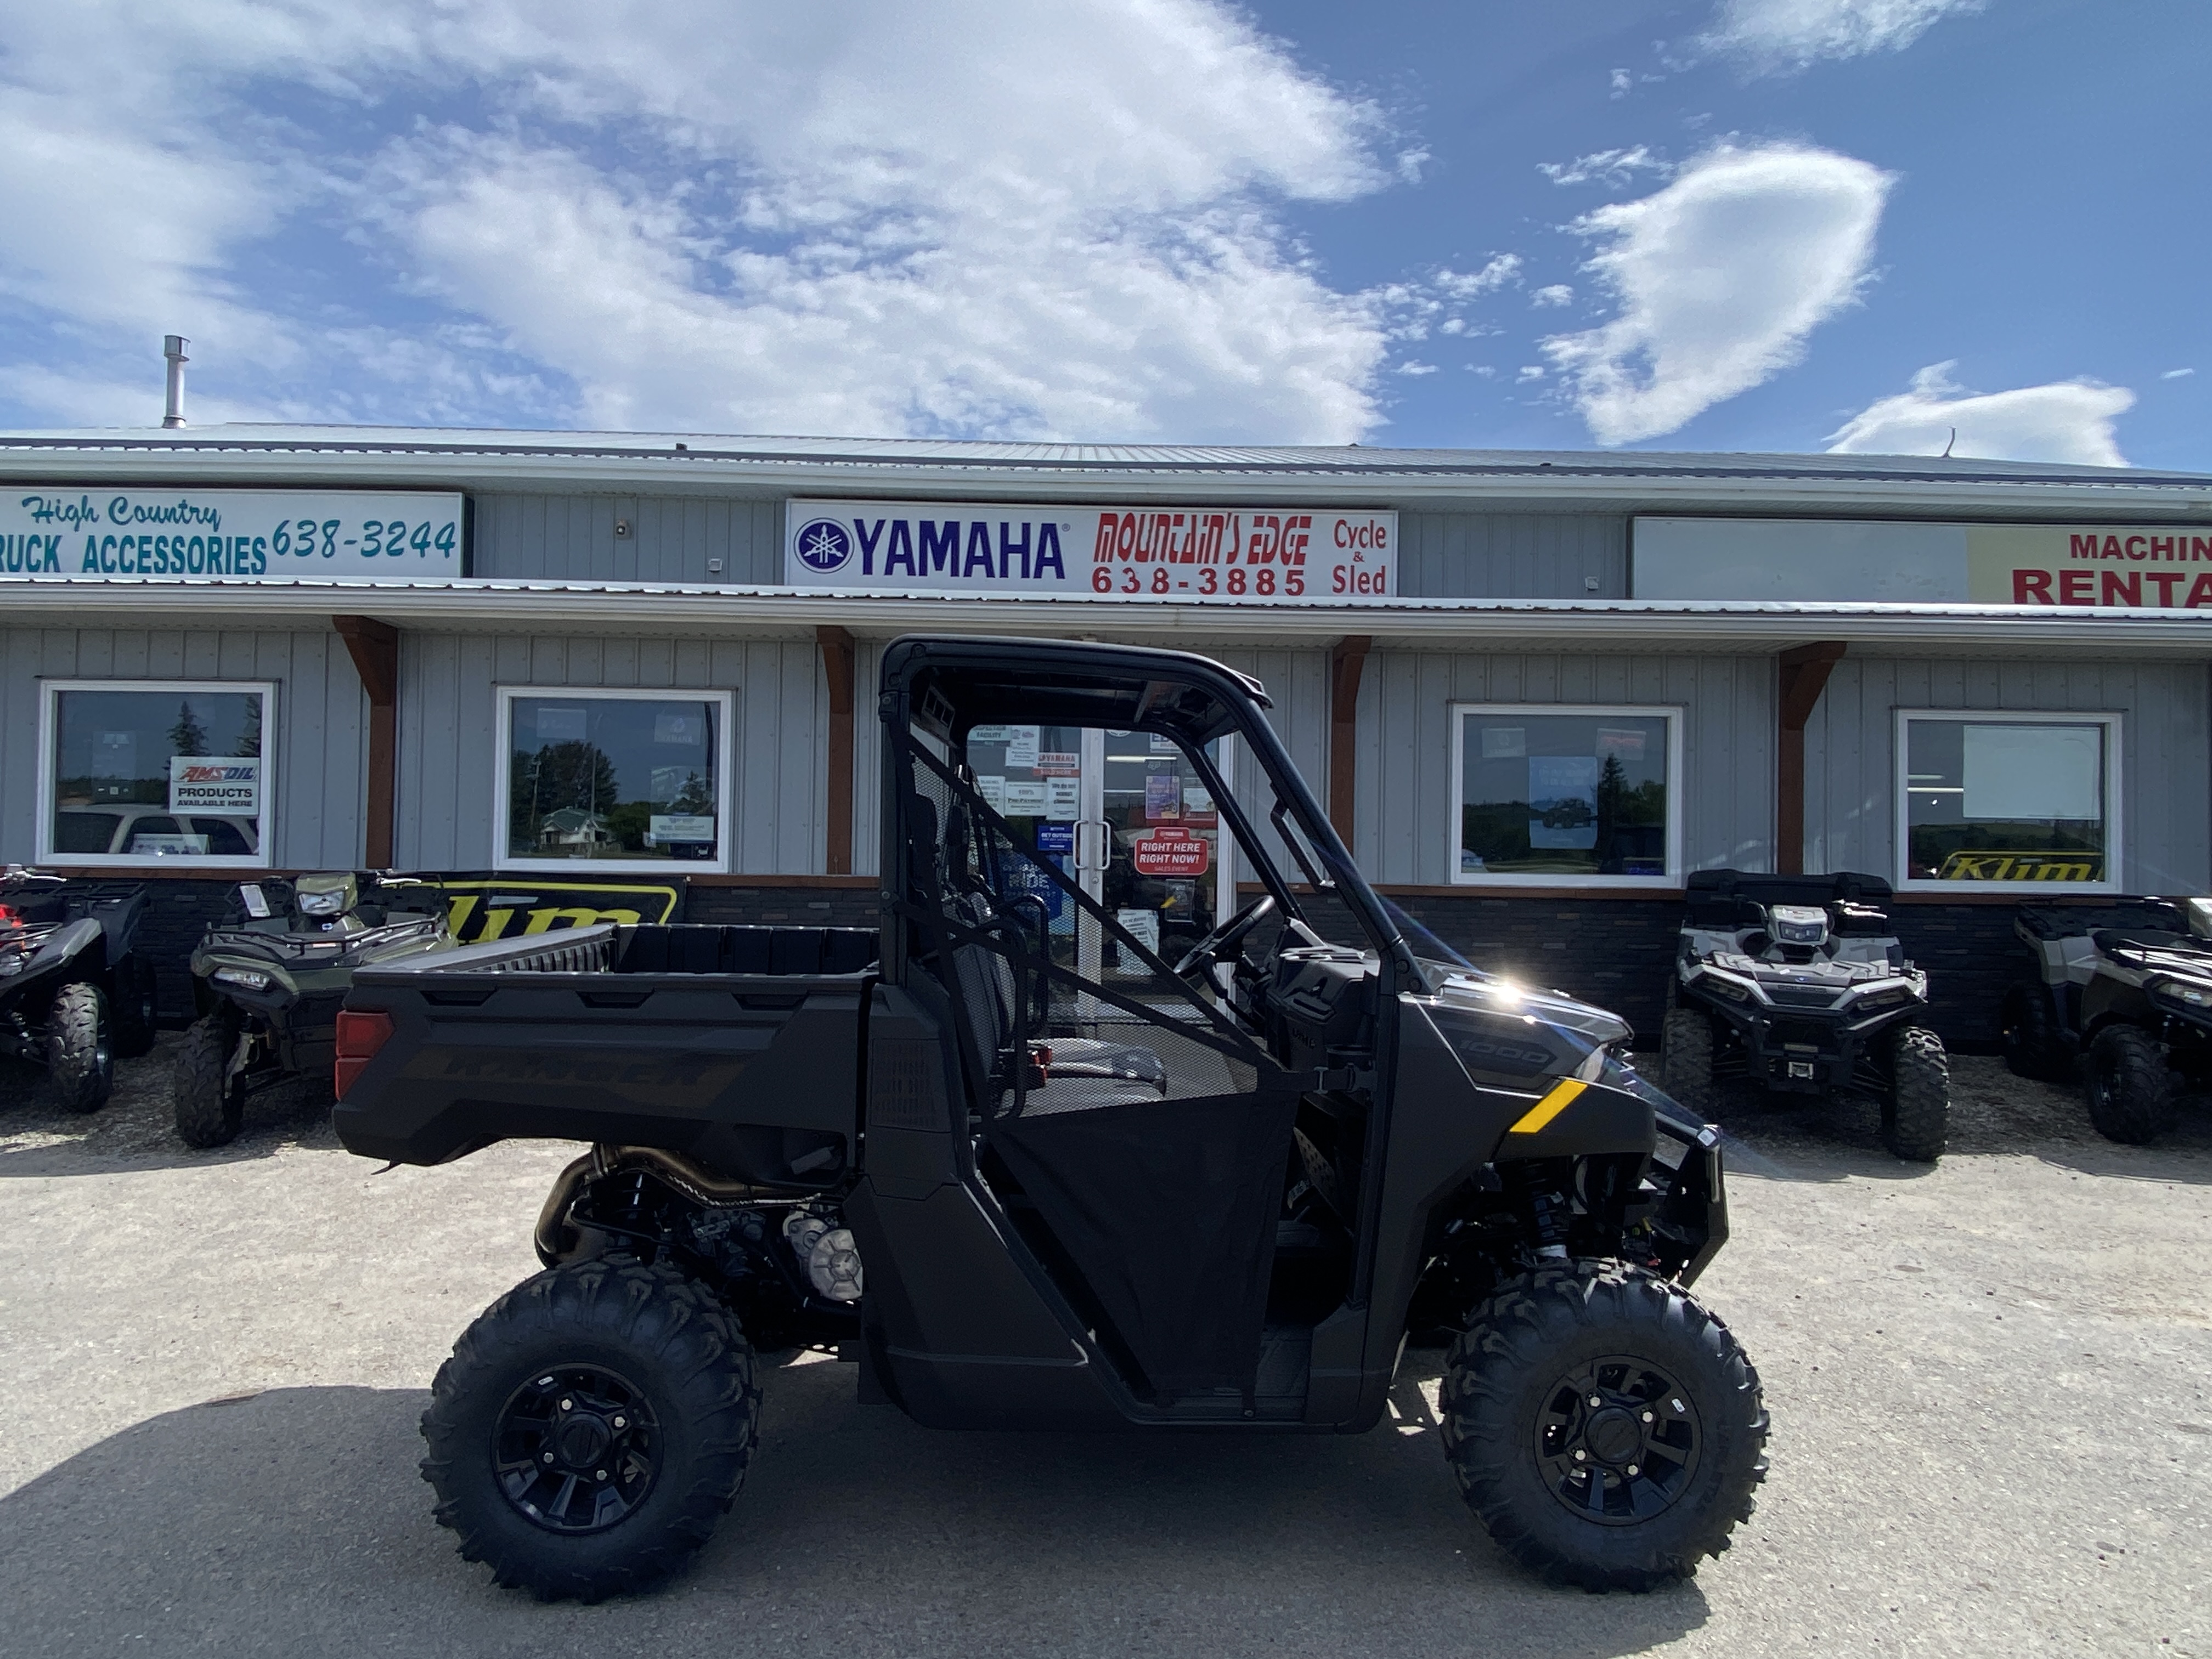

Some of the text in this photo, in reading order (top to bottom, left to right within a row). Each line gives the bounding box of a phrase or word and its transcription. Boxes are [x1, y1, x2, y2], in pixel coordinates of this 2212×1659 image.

[22, 495, 221, 532] High Country
[272, 519, 456, 558] 638-3244
[853, 518, 1066, 579] YAMAHA
[1246, 515, 1312, 566] EDGE
[1334, 519, 1386, 549] Cycle
[2070, 534, 2212, 561] MACHIN
[82, 535, 267, 574] ACCESSORIES
[1353, 551, 1365, 562] &
[1092, 566, 1305, 596] 638-3885
[1333, 565, 1386, 594] Sled
[2012, 569, 2212, 608] RENTA
[179, 766, 255, 782] AMSOIL
[178, 788, 253, 797] PRODUCTS
[1139, 854, 1200, 864] RIGHT NOW!
[1141, 843, 1201, 852] RIGHT HERE
[1459, 1041, 1549, 1064] 1000
